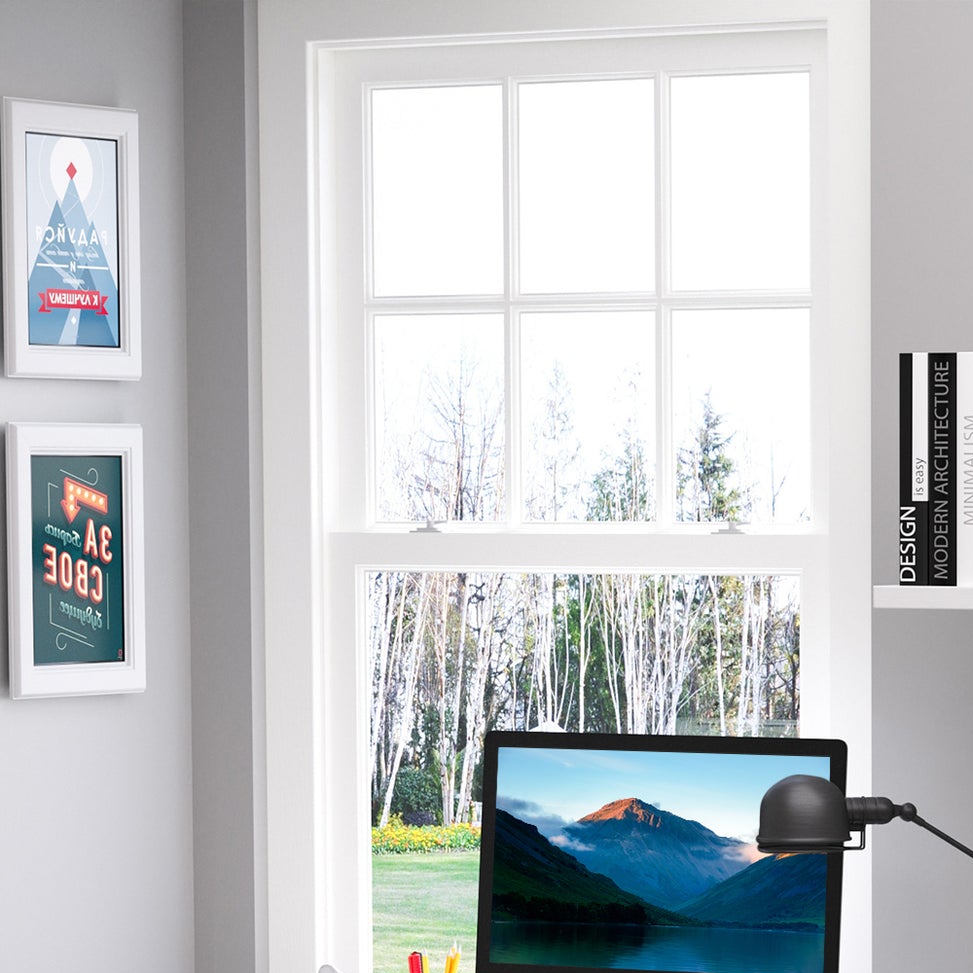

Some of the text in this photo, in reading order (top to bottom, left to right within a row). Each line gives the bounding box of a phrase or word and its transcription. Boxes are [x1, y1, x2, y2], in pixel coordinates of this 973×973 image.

[914, 457, 927, 496] is easy
[934, 361, 949, 579] MODERN ARCHITECTURE
[900, 506, 916, 583] DESIGN
